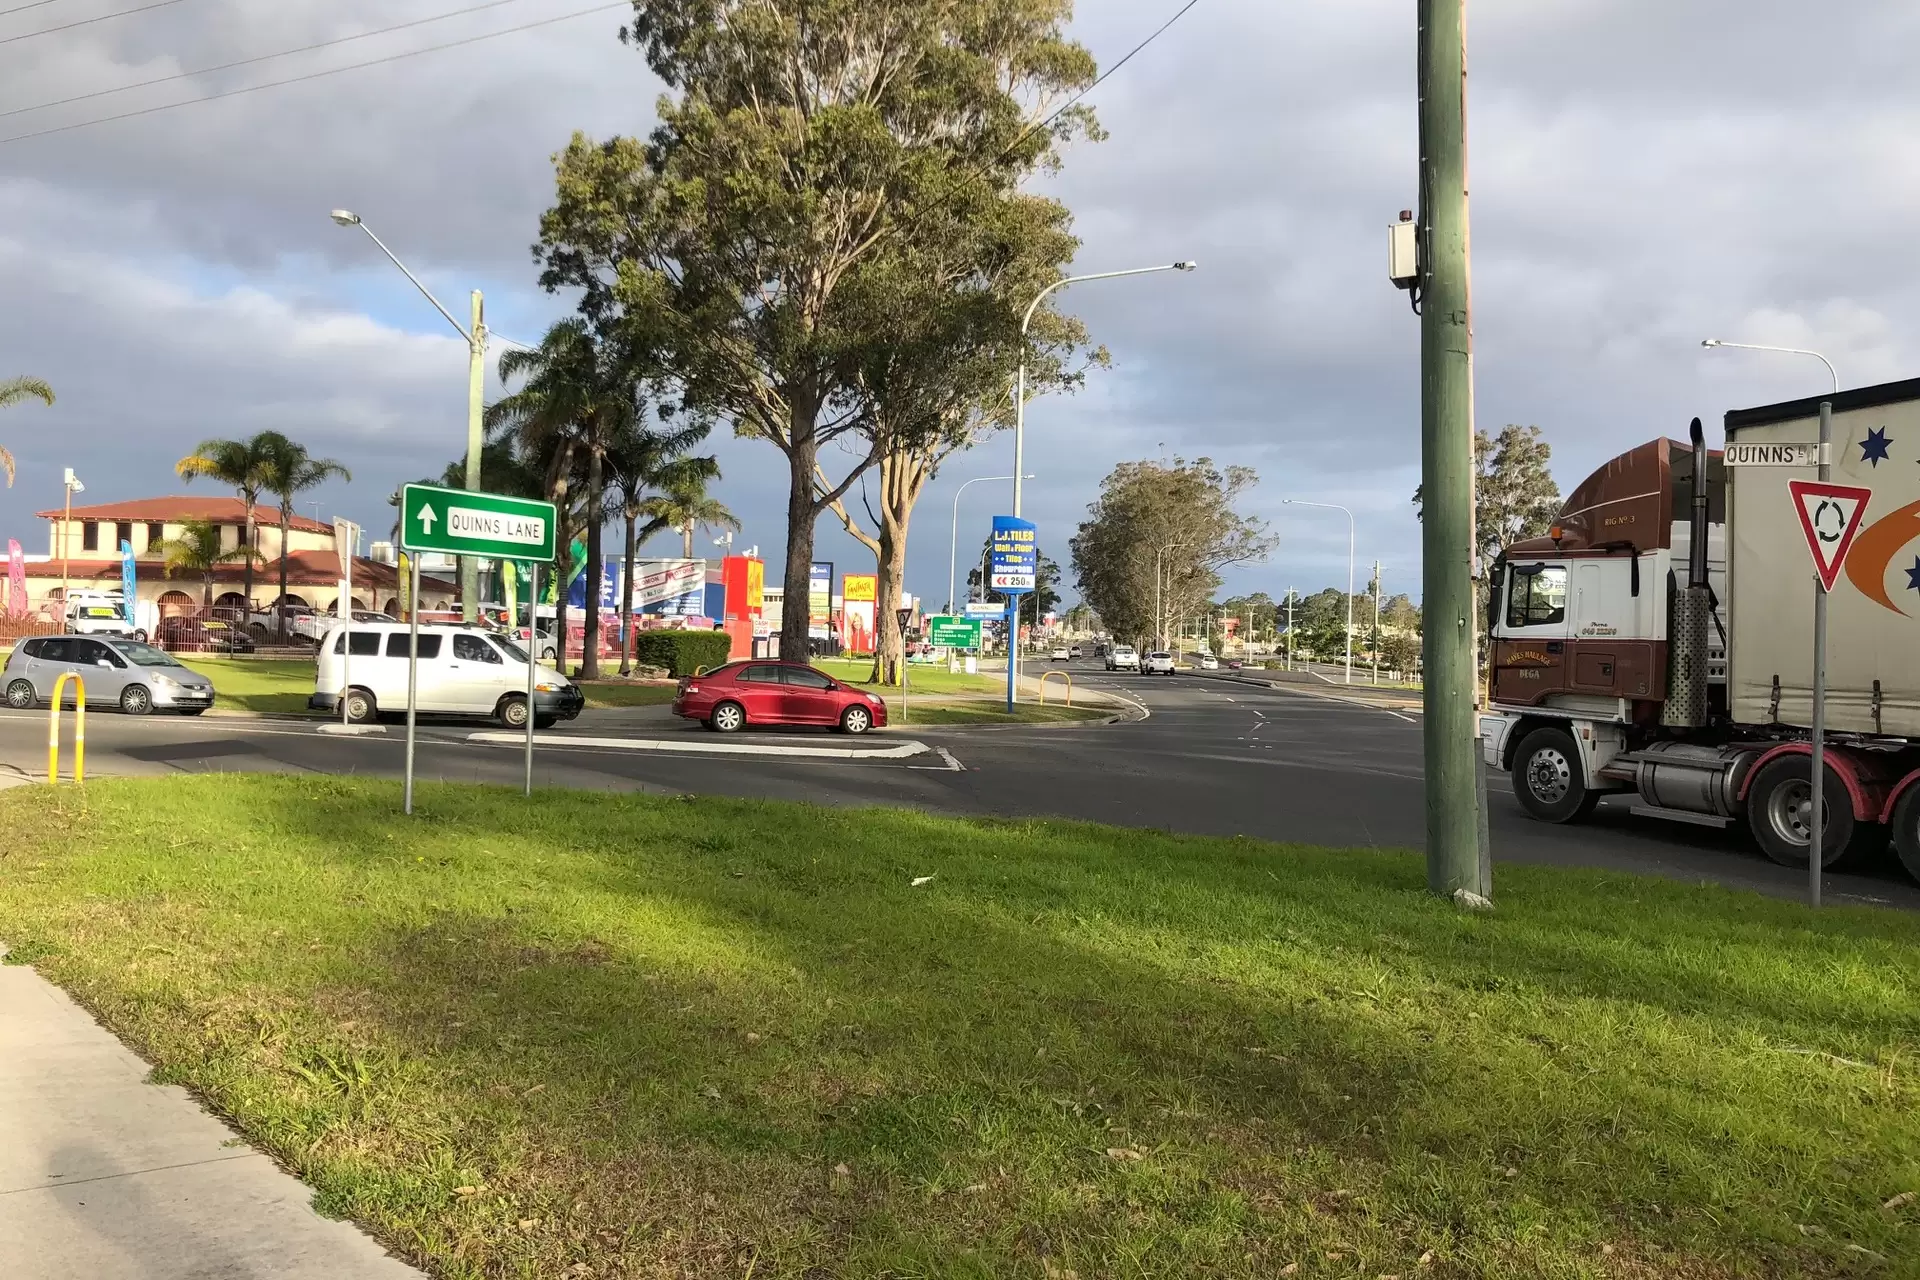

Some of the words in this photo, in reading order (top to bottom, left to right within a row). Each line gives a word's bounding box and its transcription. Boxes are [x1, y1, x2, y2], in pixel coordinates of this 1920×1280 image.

[1727, 446, 1794, 463] QUINNS
[452, 514, 501, 534] QUINNS
[507, 521, 540, 538] LANE
[1604, 517, 1617, 526] RIG
[994, 564, 1033, 574] Showroom
[1519, 668, 1540, 680] BEGA
